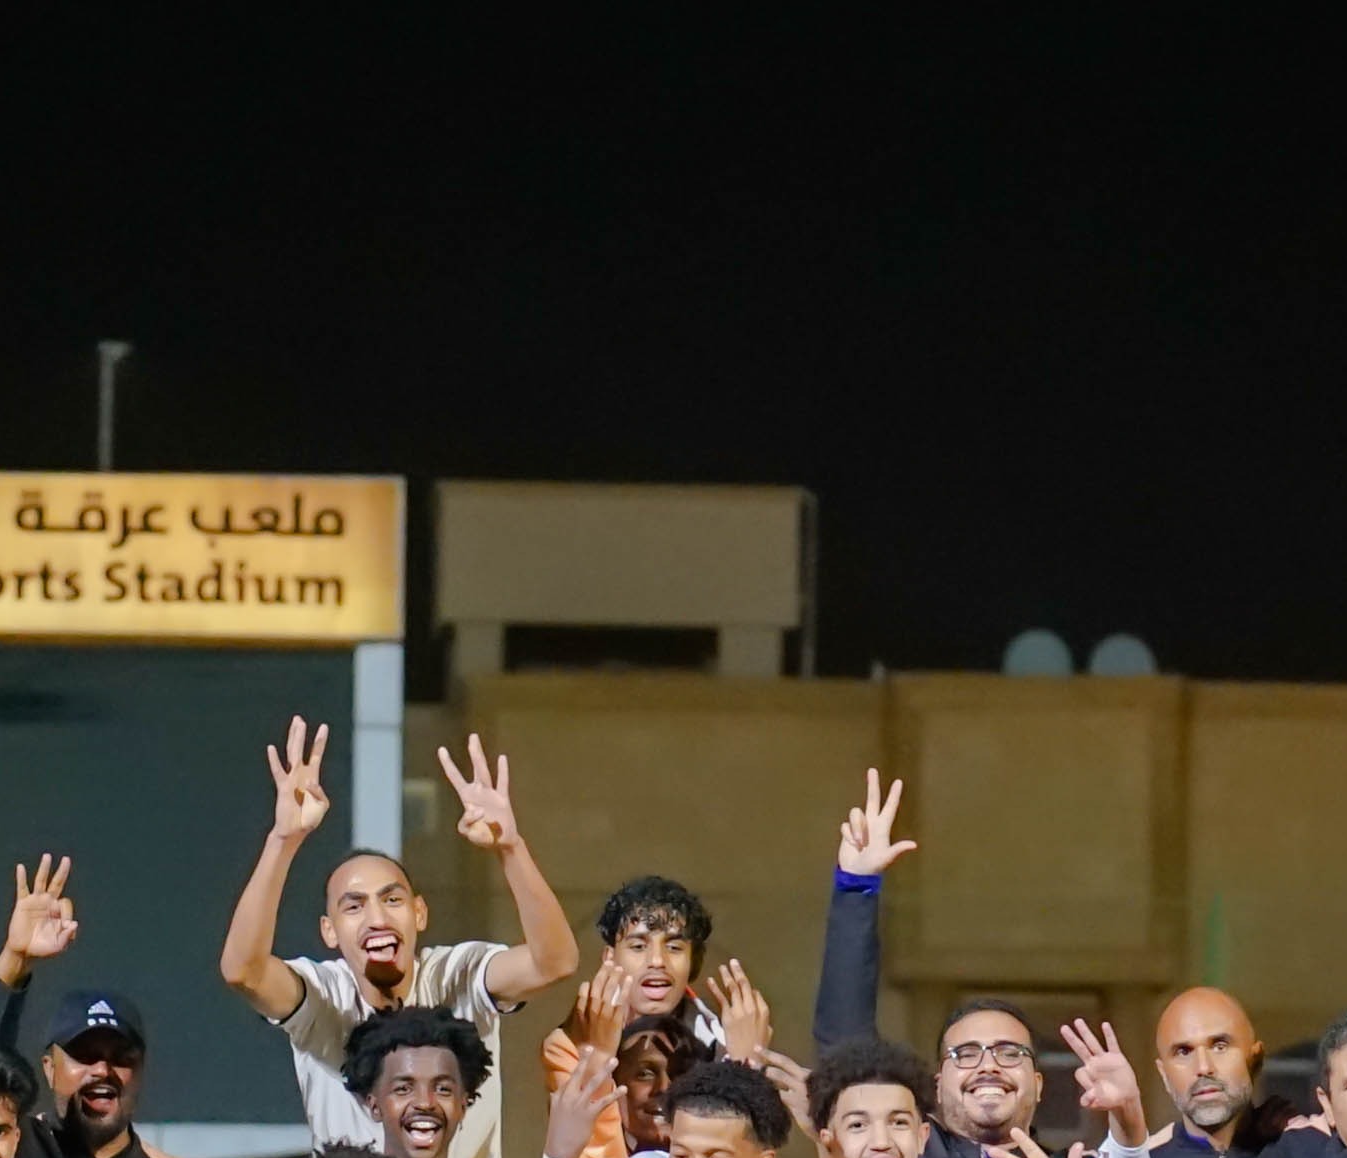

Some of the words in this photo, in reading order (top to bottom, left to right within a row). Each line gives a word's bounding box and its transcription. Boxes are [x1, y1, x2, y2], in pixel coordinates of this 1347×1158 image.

[14, 489, 167, 549] عرقة
[190, 490, 345, 548] ملعب
[104, 560, 344, 607] Stadium
